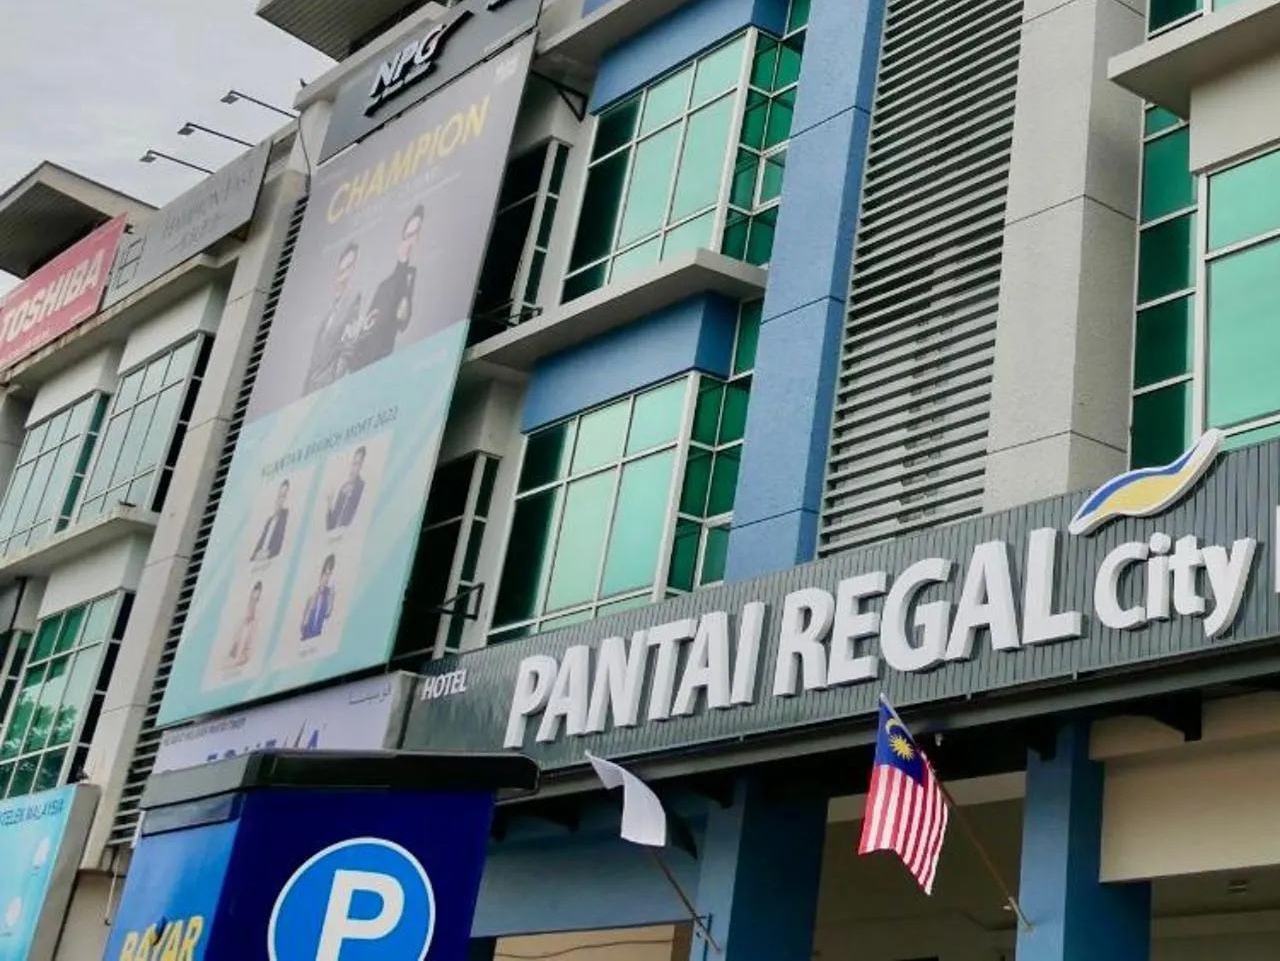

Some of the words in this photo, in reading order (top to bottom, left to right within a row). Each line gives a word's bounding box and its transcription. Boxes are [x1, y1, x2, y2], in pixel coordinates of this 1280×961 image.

[370, 23, 447, 98] NPG
[327, 93, 491, 224] CHAMPION
[0, 248, 106, 342] TOSHIBA
[503, 601, 766, 749] PANTAI
[772, 526, 1083, 698] REGAL
[1094, 532, 1258, 639] City
[421, 668, 469, 701] HOTEL
[120, 914, 204, 961] BAYAR
[315, 869, 405, 961] P
